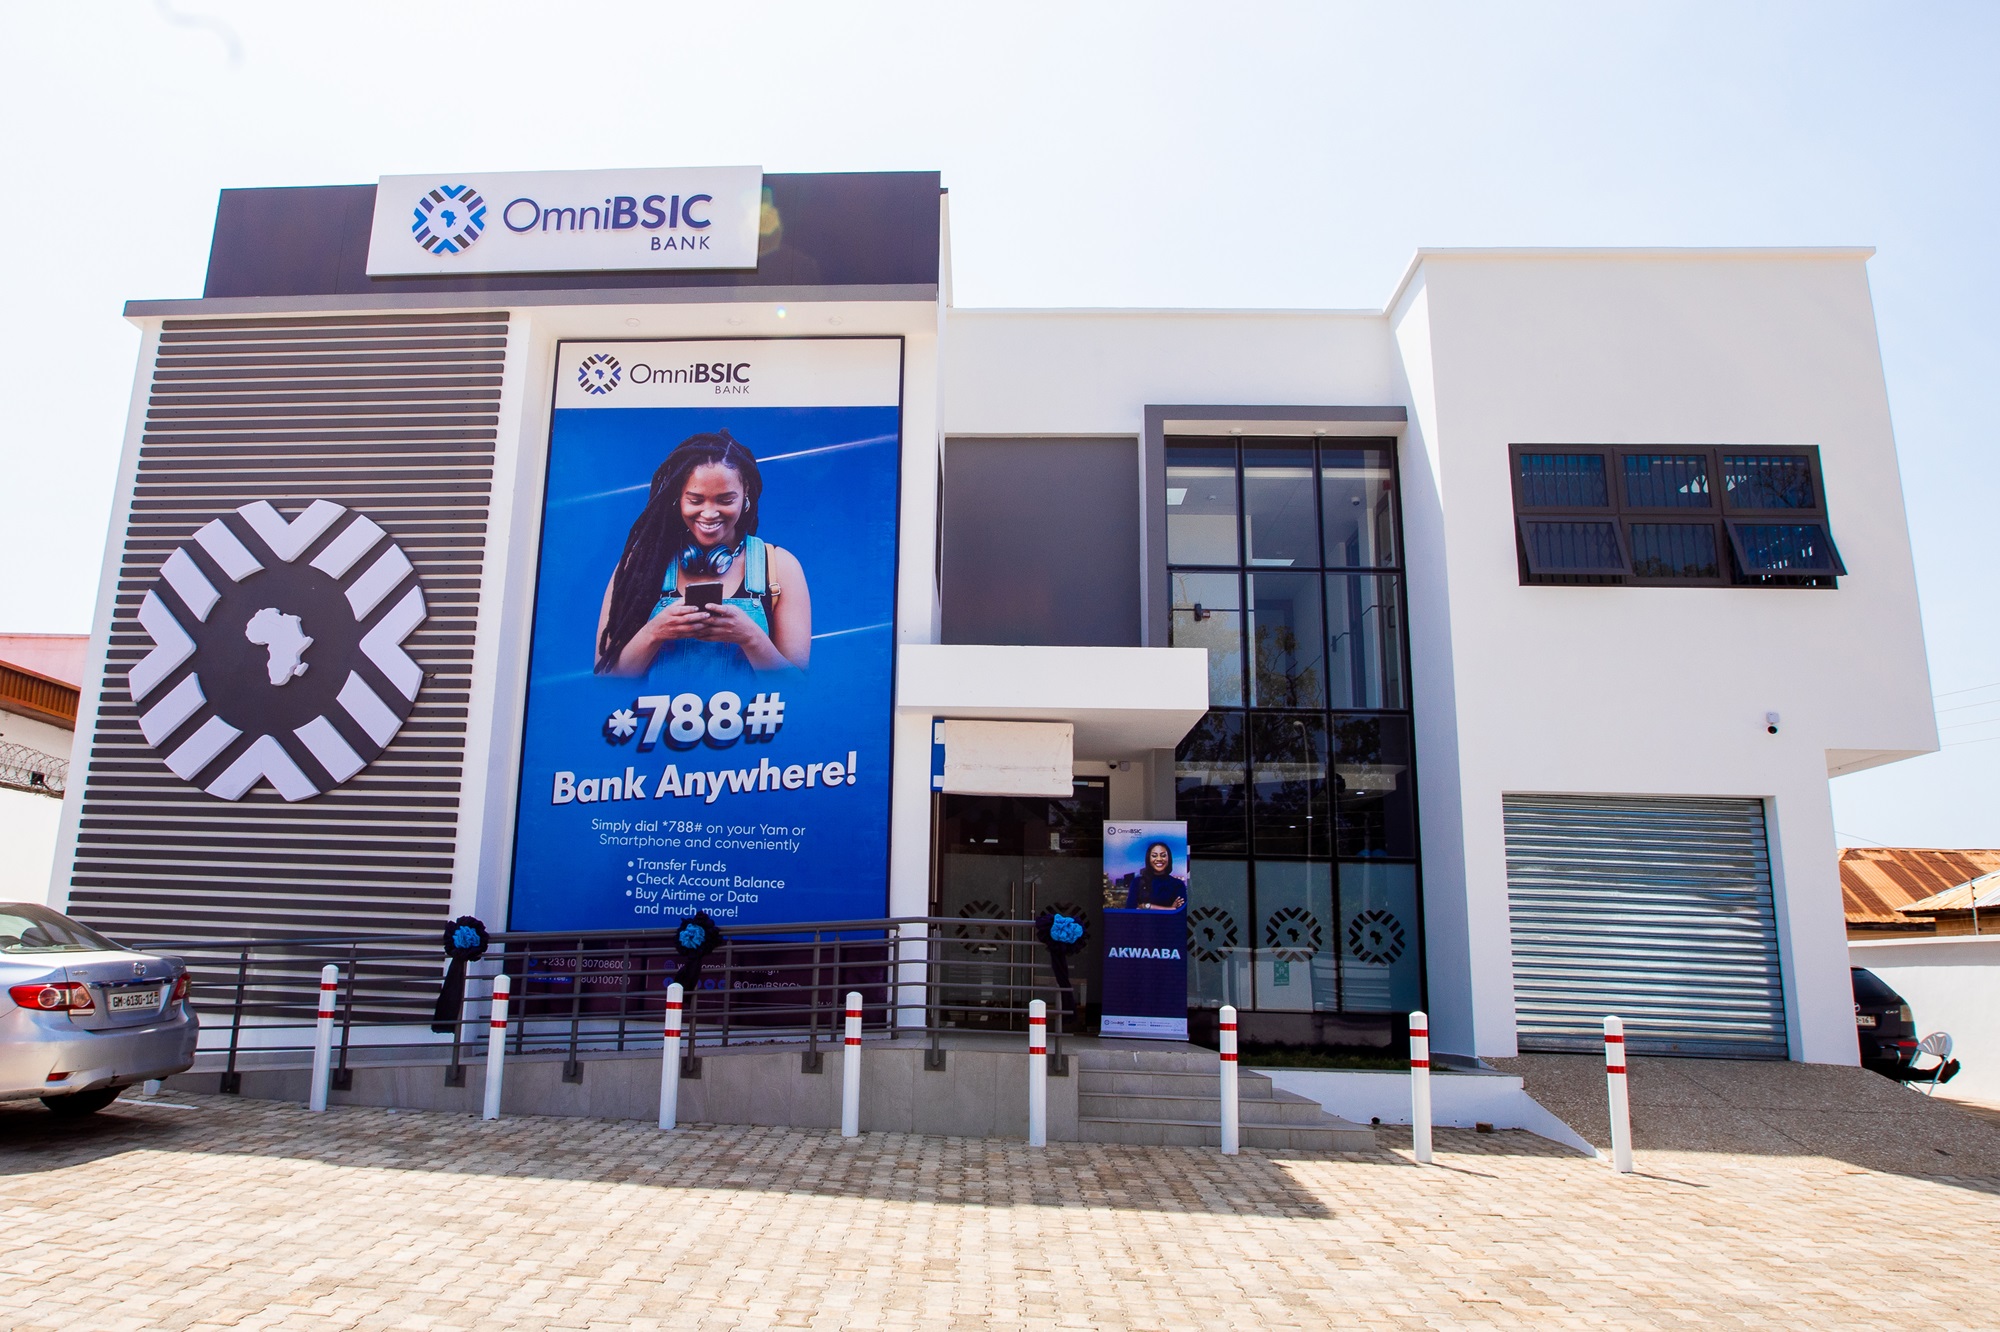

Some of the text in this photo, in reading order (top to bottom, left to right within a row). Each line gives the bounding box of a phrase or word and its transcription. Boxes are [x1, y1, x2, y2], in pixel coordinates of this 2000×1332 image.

[503, 194, 713, 233] OmniBSIC
[651, 236, 710, 251] BANK
[630, 363, 751, 384] OmniBSIC
[715, 385, 750, 394] BANK
[553, 751, 857, 804] Bank Anywhere!
[591, 818, 631, 834] Simply
[635, 820, 658, 832] dial
[706, 825, 723, 834] on
[727, 825, 756, 837] your
[759, 823, 788, 836] Yam
[791, 826, 805, 836] or
[599, 834, 800, 853] Smartphone and conveniently
[637, 858, 727, 872] Transfer Funds
[636, 872, 785, 889] Check Account Balance
[635, 887, 759, 903] Buy Airtime or Data
[634, 902, 739, 917] and much more!
[1108, 947, 1181, 959] AKWAABA
